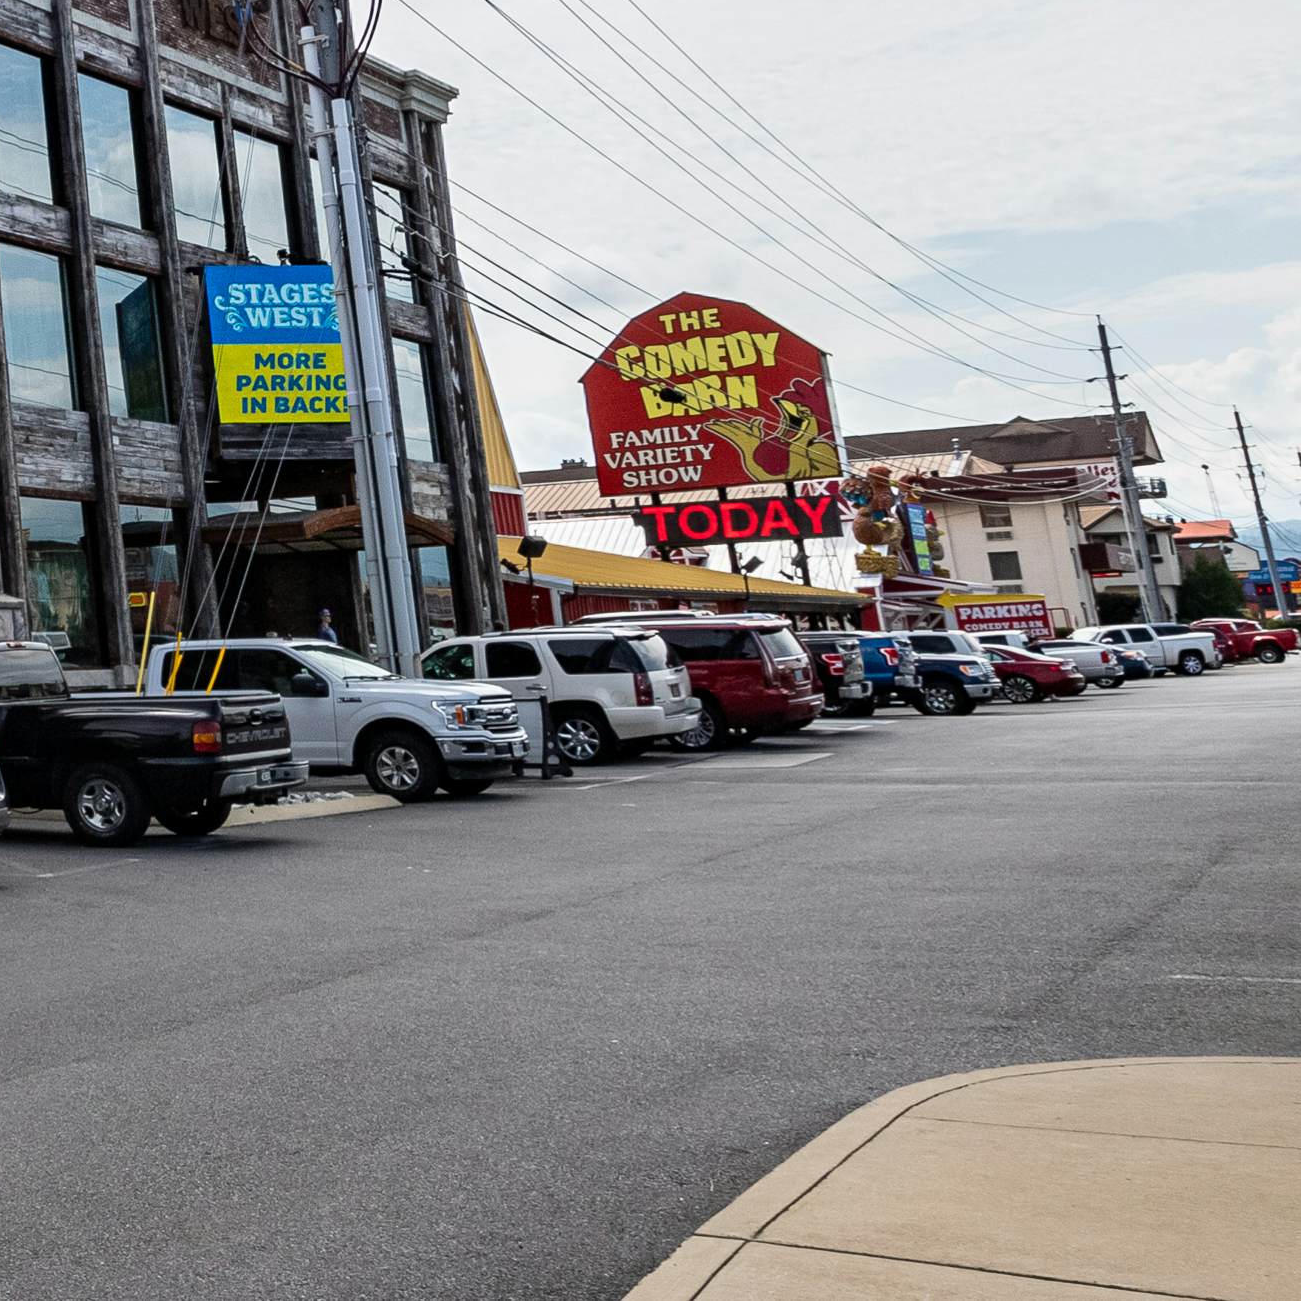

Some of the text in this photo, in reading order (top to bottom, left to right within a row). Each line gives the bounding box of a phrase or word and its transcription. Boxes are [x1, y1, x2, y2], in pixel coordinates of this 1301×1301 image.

[227, 282, 337, 306] STAGES
[244, 306, 325, 329] WEST
[658, 307, 722, 334] THE
[254, 352, 327, 370] MORE
[613, 330, 780, 382] COMEDY
[236, 374, 347, 392] PARKING
[241, 396, 268, 414] IN
[639, 374, 759, 420] BARN
[609, 423, 703, 450] FAMILY
[603, 443, 715, 471] VARIETY
[622, 464, 703, 489] SHOW
[641, 496, 833, 543] TODAY
[959, 603, 1045, 620] PARKING
[964, 620, 1045, 632] COMEDY BARN
